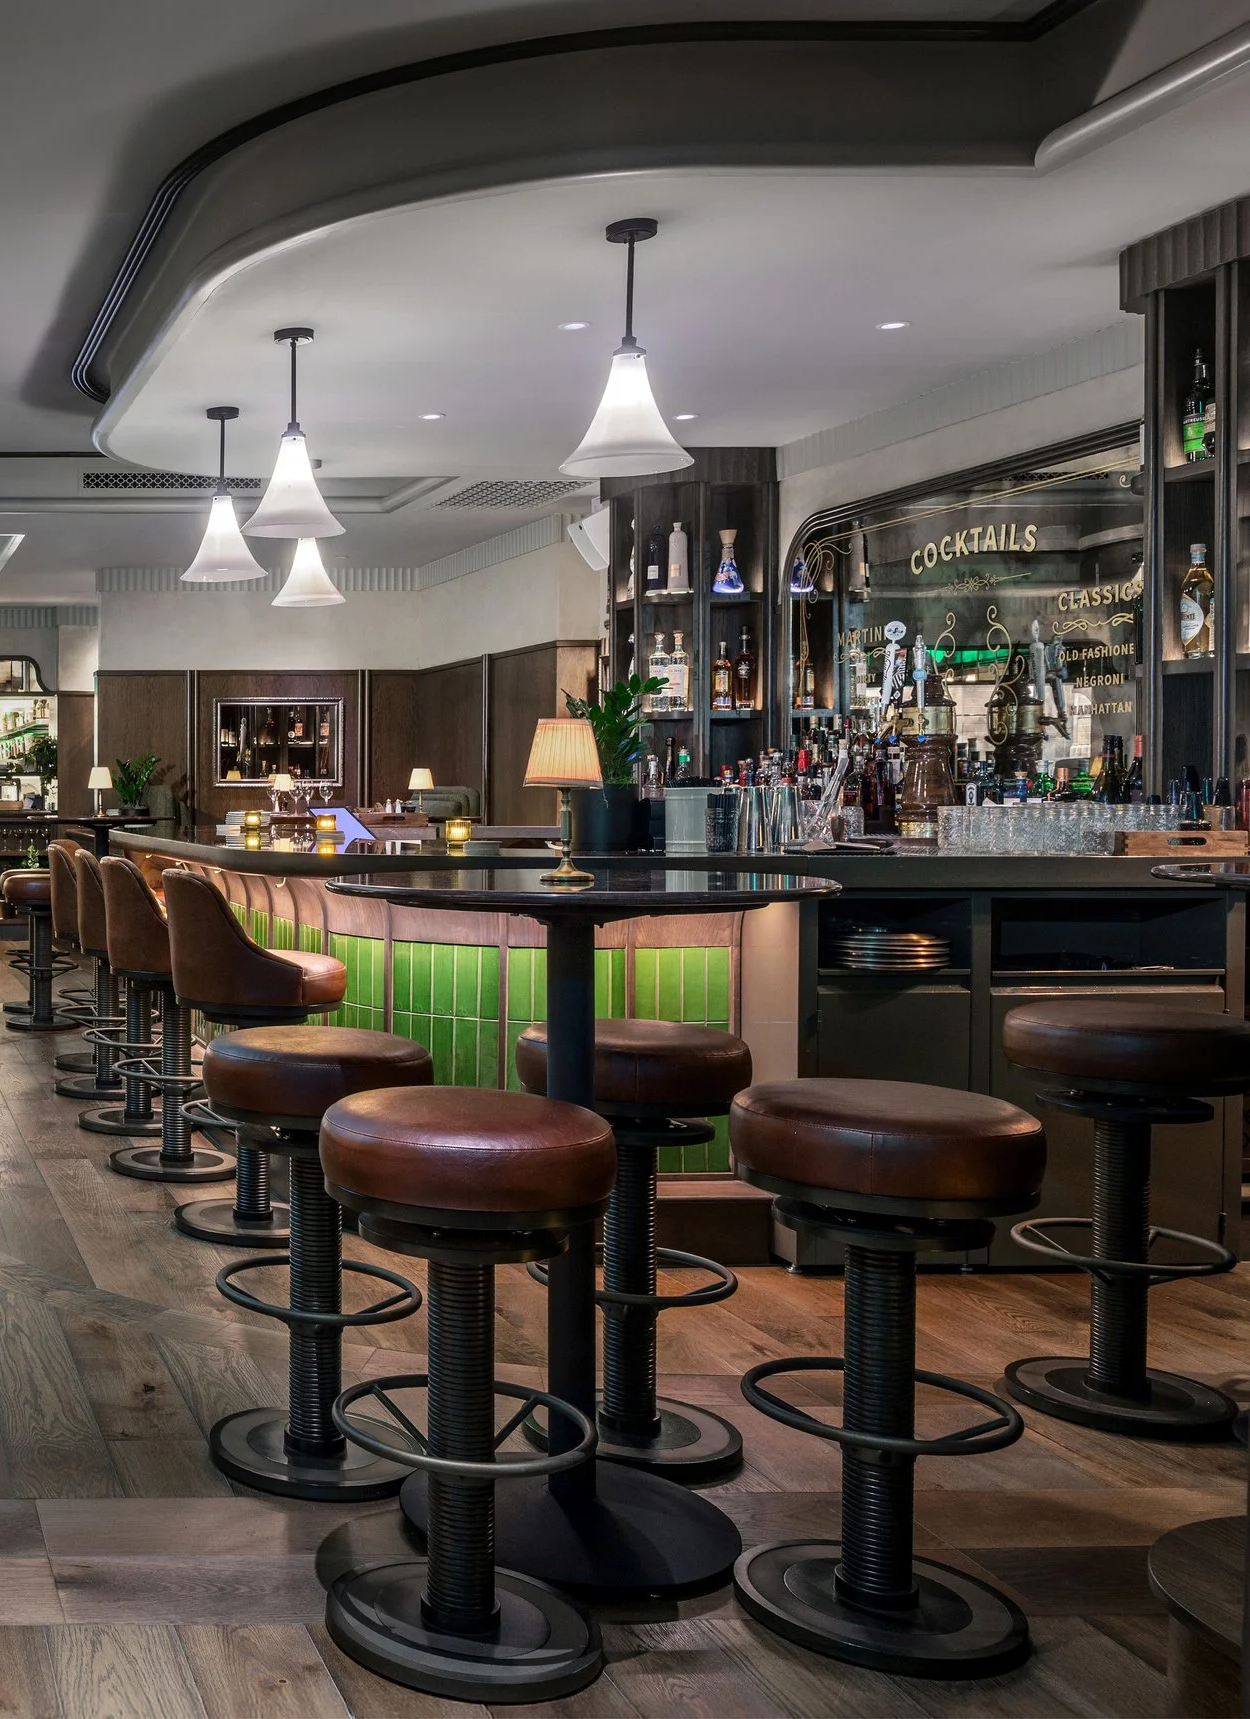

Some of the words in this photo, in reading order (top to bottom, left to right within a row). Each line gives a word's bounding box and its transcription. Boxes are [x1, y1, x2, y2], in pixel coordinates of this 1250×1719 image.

[911, 523, 1038, 575] COCKTAILS
[1058, 580, 1144, 611] CLASSICS
[1058, 650, 1079, 661] OLD
[1082, 643, 1134, 660] FASHIONE
[1076, 673, 1124, 688] NEGRONI
[1069, 701, 1133, 716] MANHATTAN
